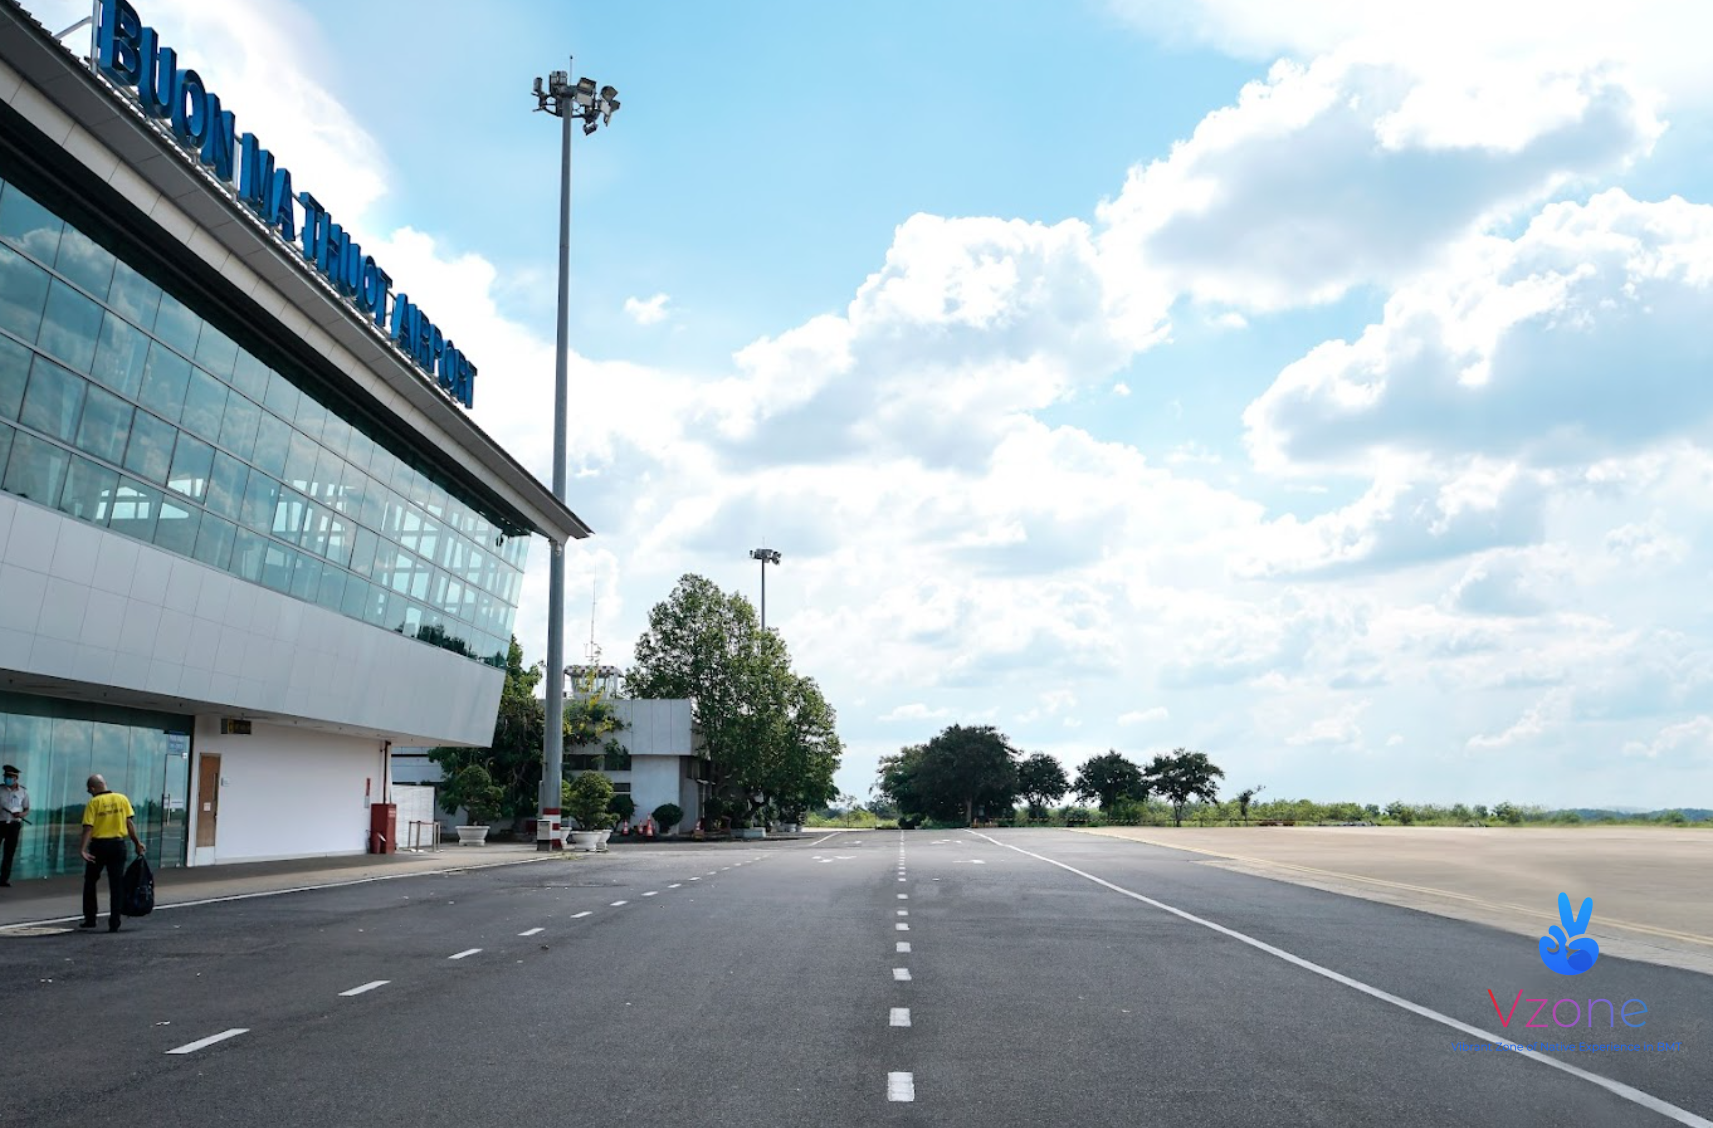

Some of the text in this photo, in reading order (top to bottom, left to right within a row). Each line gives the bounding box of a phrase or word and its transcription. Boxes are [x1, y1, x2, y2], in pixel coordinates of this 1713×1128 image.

[97, 0, 478, 409] BUON MA THUOT AIRPORT
